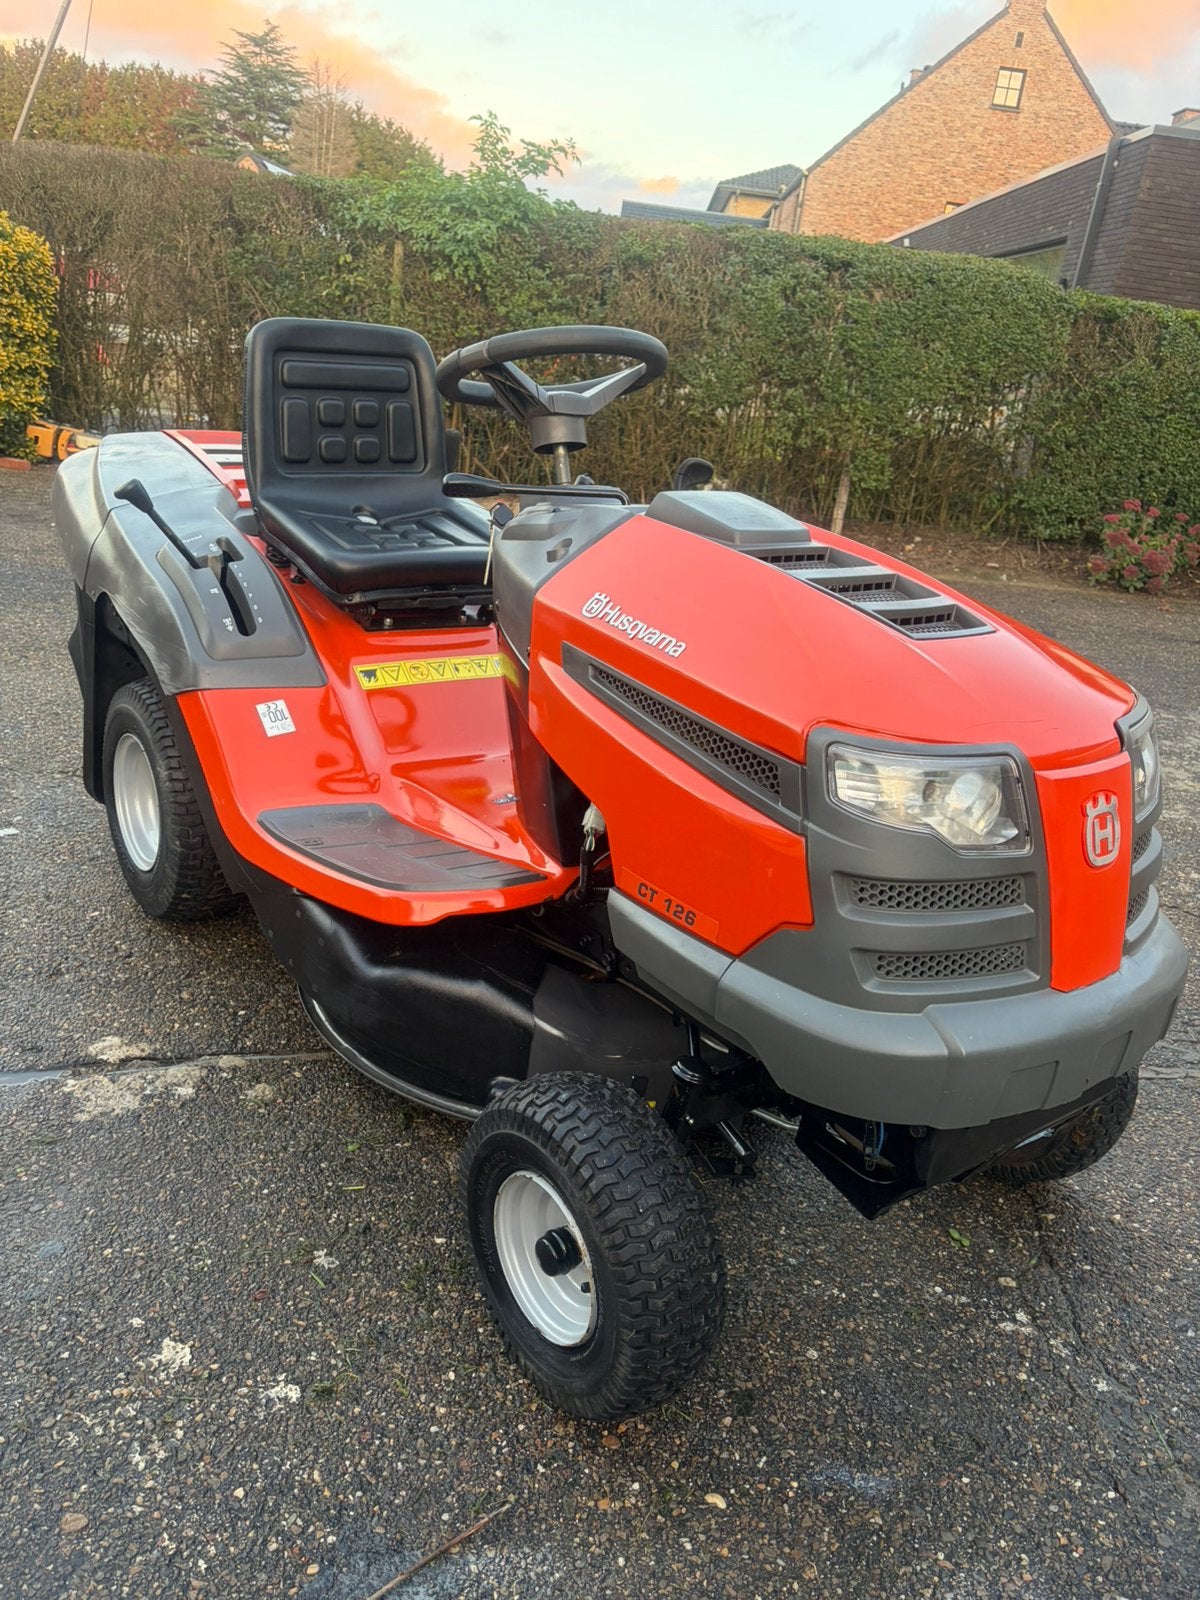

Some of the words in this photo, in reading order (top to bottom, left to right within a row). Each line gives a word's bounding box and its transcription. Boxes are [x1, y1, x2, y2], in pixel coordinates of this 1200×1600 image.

[597, 602, 687, 657] Husqvarna
[267, 708, 289, 723] 100
[637, 882, 658, 903] CT
[664, 898, 697, 927] 126
